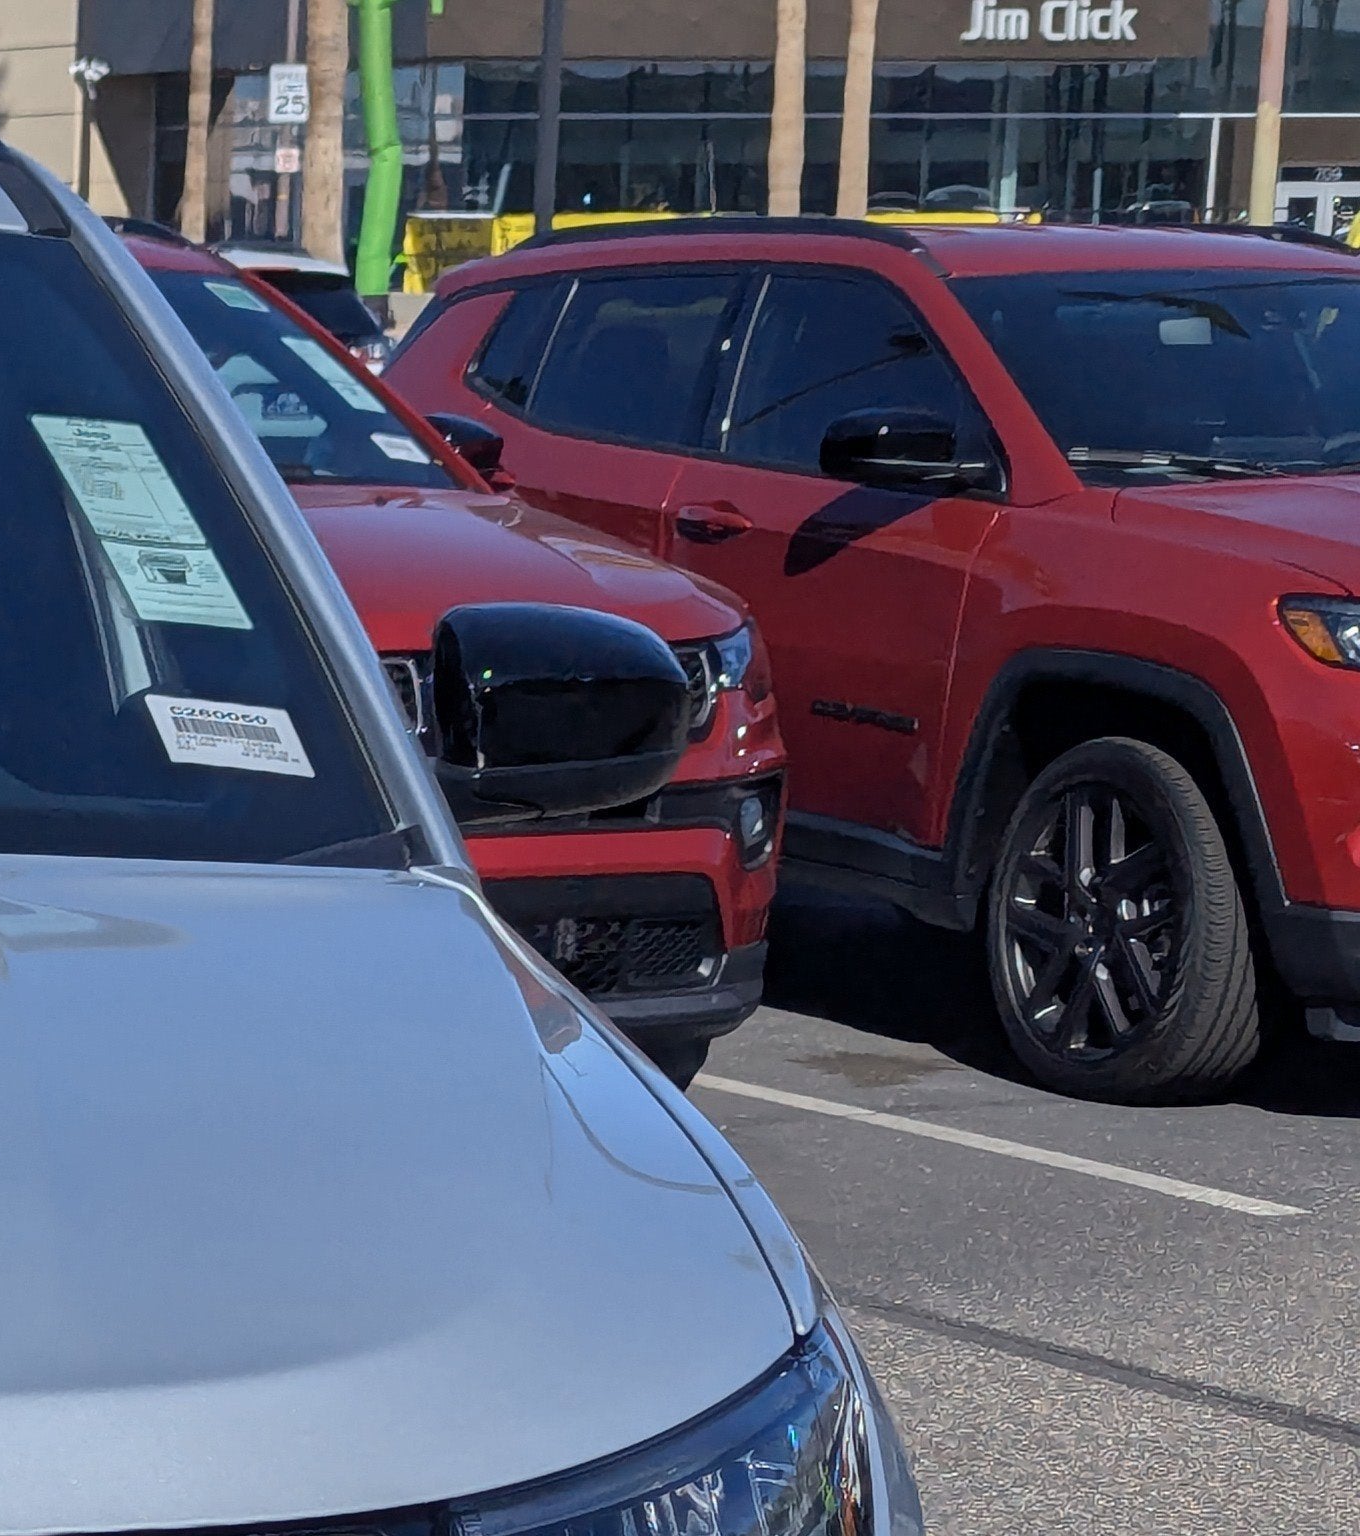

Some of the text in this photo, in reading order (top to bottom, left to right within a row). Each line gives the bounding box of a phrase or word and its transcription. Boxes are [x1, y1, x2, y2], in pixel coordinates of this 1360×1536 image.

[960, 0, 1139, 41] Jim Click
[275, 95, 306, 115] 25
